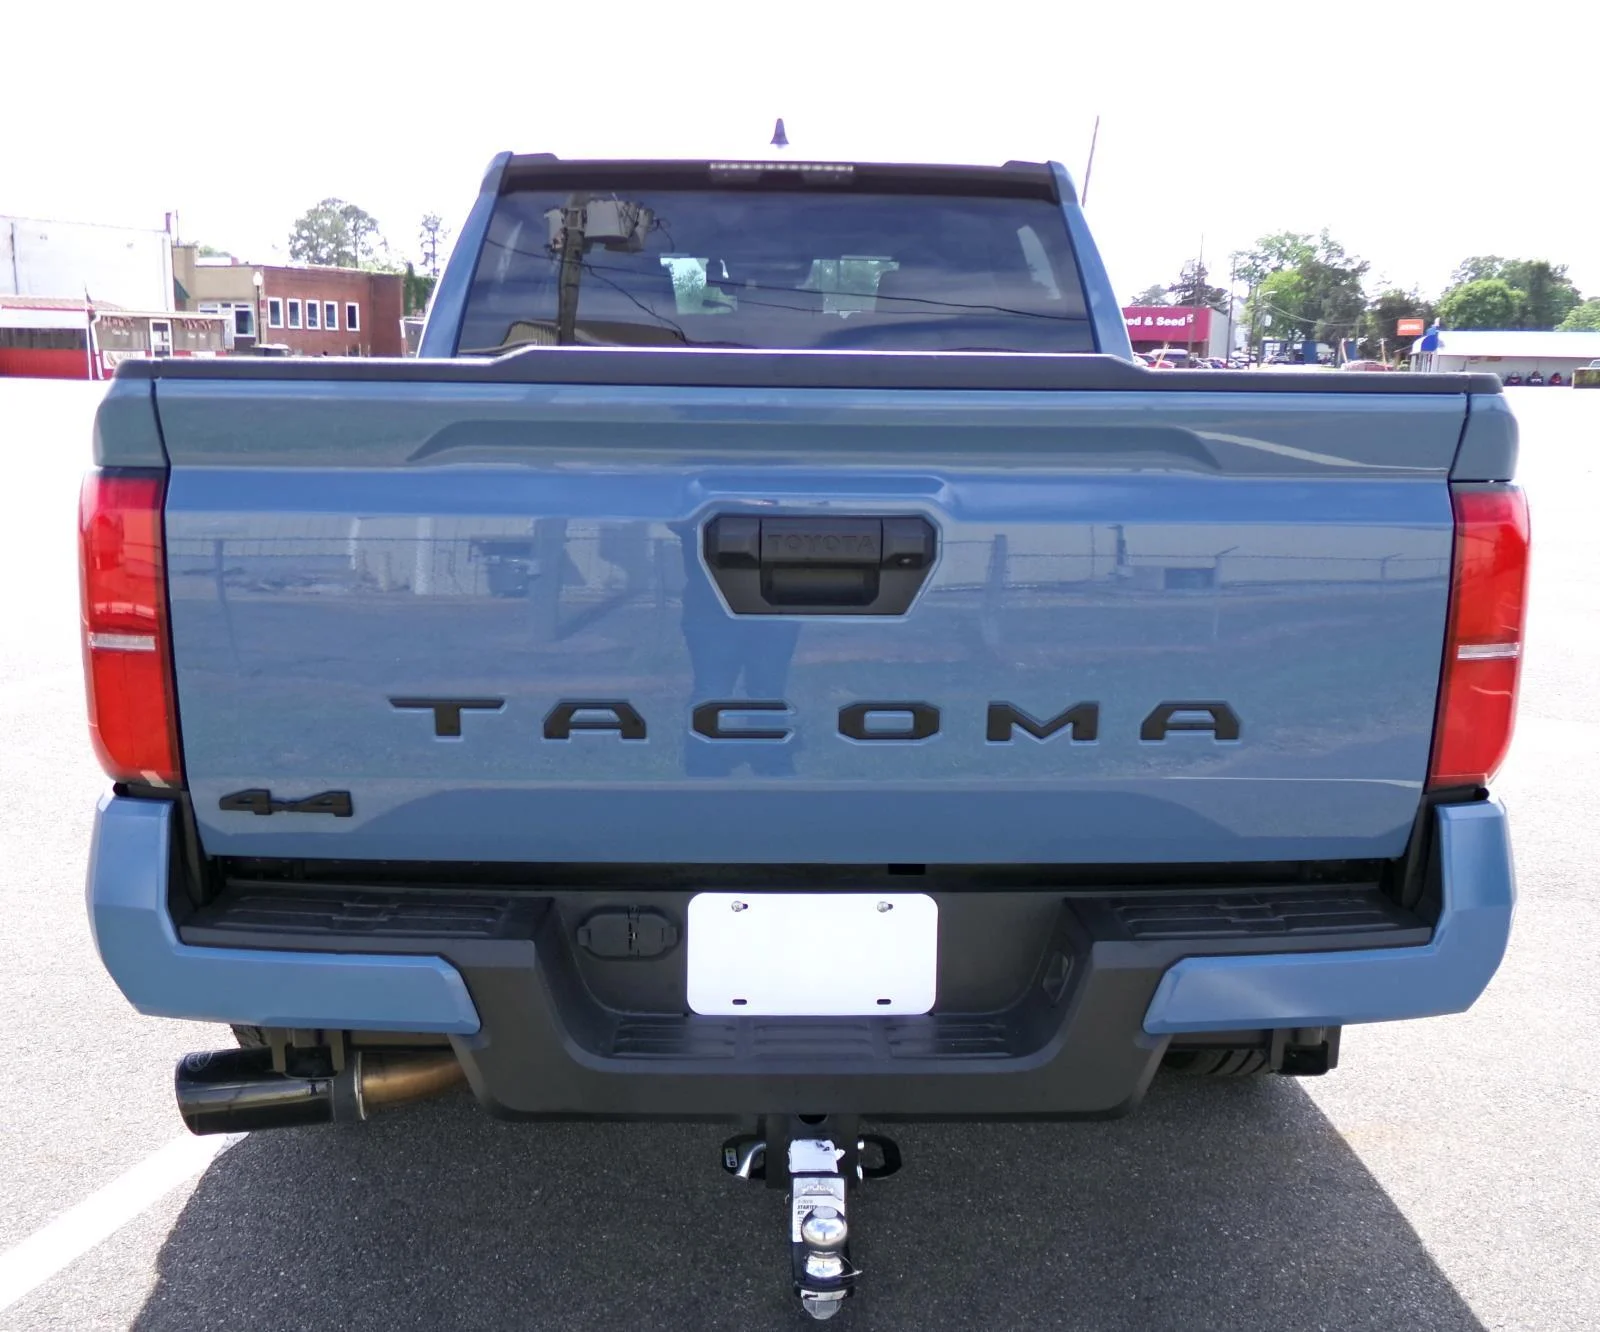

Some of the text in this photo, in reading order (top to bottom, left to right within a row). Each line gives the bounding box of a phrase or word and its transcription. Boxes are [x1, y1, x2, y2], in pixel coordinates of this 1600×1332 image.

[1125, 316, 1141, 325] ed
[1145, 316, 1153, 325] &
[1156, 316, 1186, 326] Seed
[767, 533, 876, 553] TOYOTA
[388, 697, 1242, 743] TACOMA
